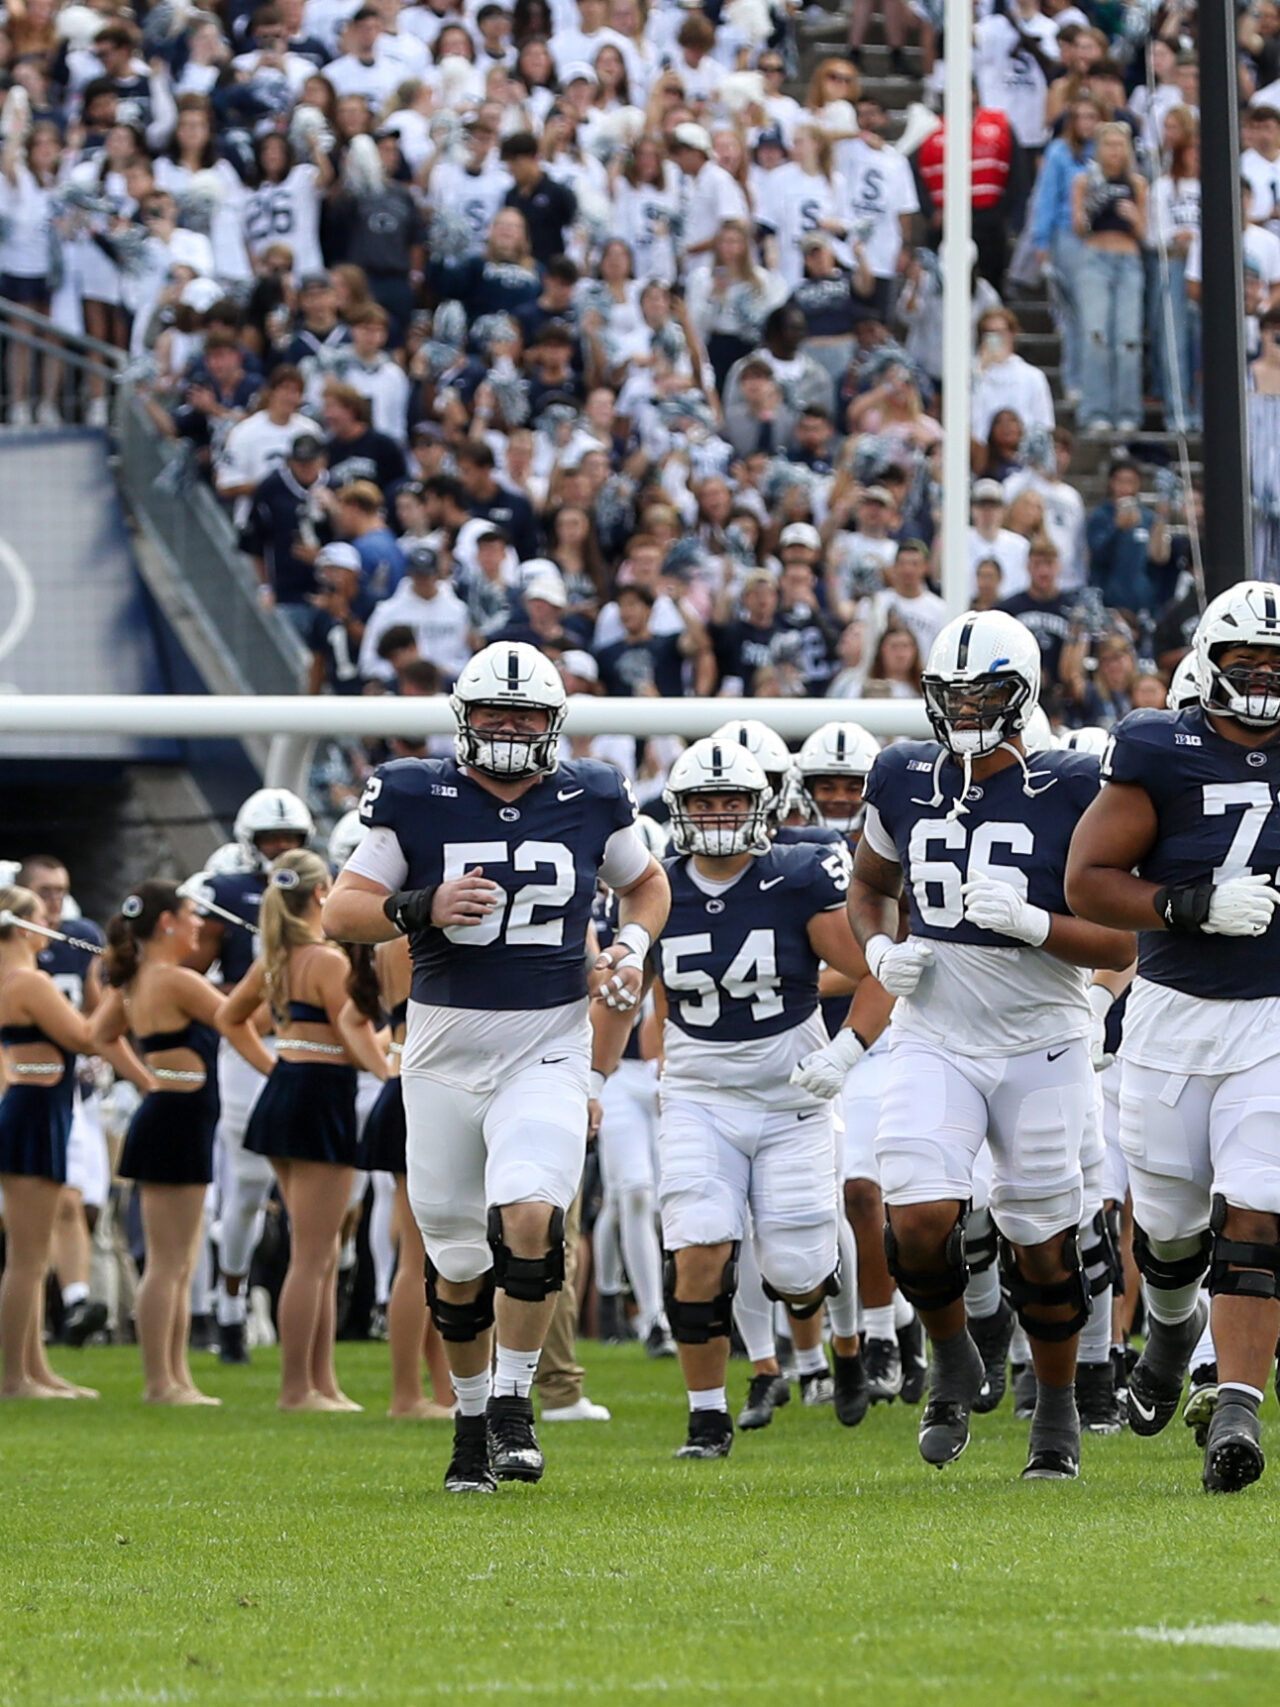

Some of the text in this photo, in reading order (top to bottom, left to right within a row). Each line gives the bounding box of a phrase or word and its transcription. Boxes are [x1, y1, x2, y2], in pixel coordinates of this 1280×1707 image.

[443, 840, 576, 946] 52
[908, 818, 1034, 928] 66
[660, 929, 785, 1028] 54
